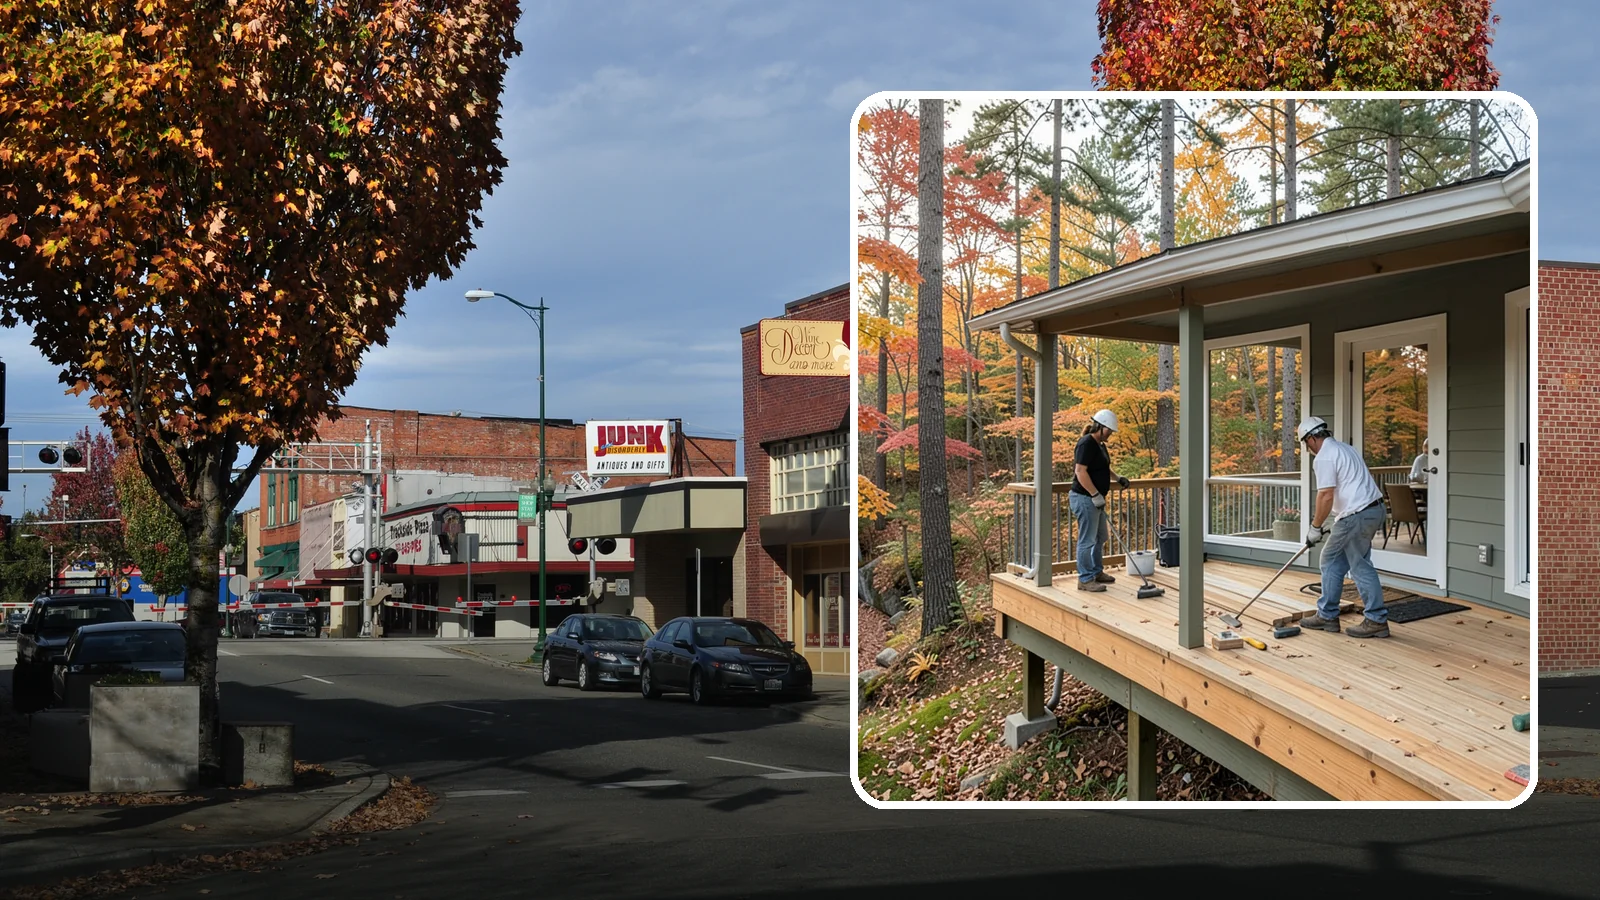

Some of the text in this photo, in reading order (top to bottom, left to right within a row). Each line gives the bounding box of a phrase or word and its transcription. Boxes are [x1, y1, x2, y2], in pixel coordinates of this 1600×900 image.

[595, 425, 665, 457] JUNK
[607, 446, 646, 454] DISORDERLY
[597, 460, 665, 470] ANTIQUES AND GIFTS
[390, 519, 429, 540] Trackside Pizza
